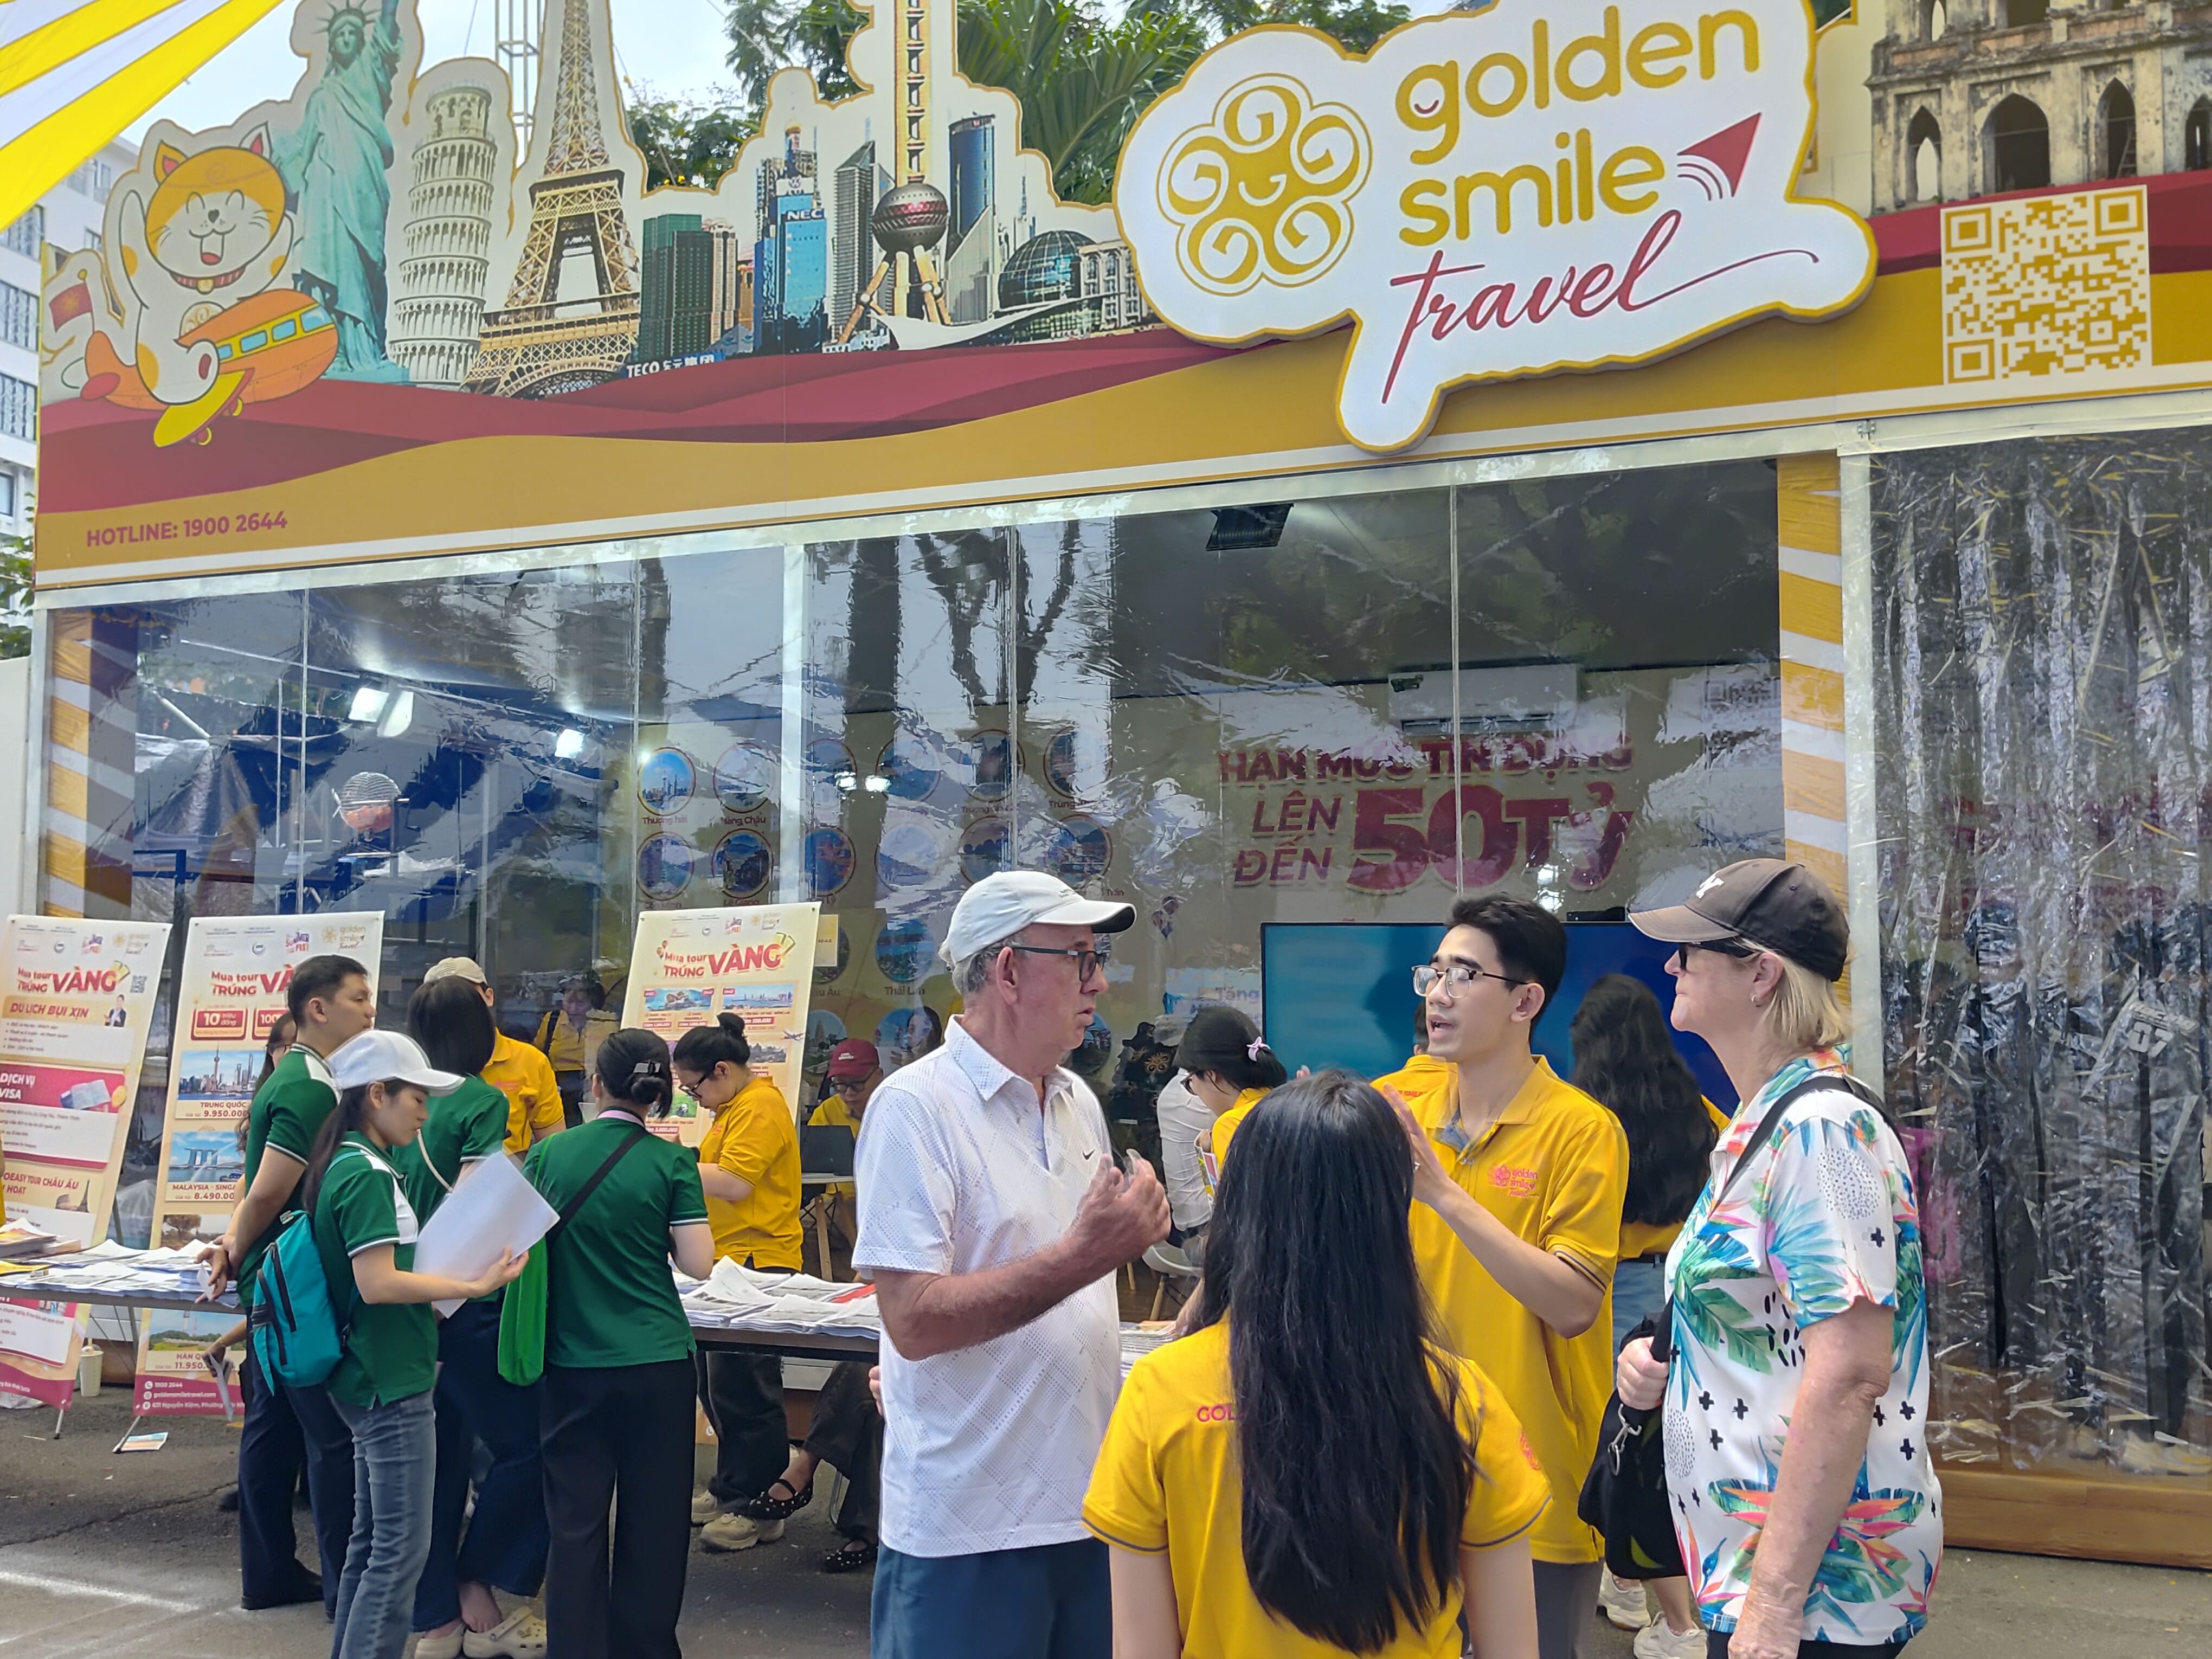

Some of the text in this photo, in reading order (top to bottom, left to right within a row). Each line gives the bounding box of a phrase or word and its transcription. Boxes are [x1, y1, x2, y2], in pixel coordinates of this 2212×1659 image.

[1396, 4, 1761, 165] golden
[1399, 127, 1666, 247] smile
[787, 208, 823, 221] NEC
[626, 361, 660, 378] TECO
[87, 511, 288, 547] HOTLINE: 1900 2644
[1251, 790, 1342, 834] LÊN
[1232, 836, 1333, 884] ĐẾN
[687, 953, 708, 963] tour
[708, 943, 782, 975] VÀNG
[33, 970, 52, 979] tour
[211, 970, 260, 982] Mua tour
[663, 964, 705, 977] TRÚNG
[53, 966, 118, 994] VÀNG
[260, 963, 294, 994] VÀ
[211, 982, 257, 996] TRÚNG
[10, 1002, 25, 1013] DU
[204, 1012, 221, 1026] 10
[3, 1172, 27, 1184] OEASY
[1512, 1168, 1538, 1179] golden
[175, 1361, 206, 1369] 11.950.
